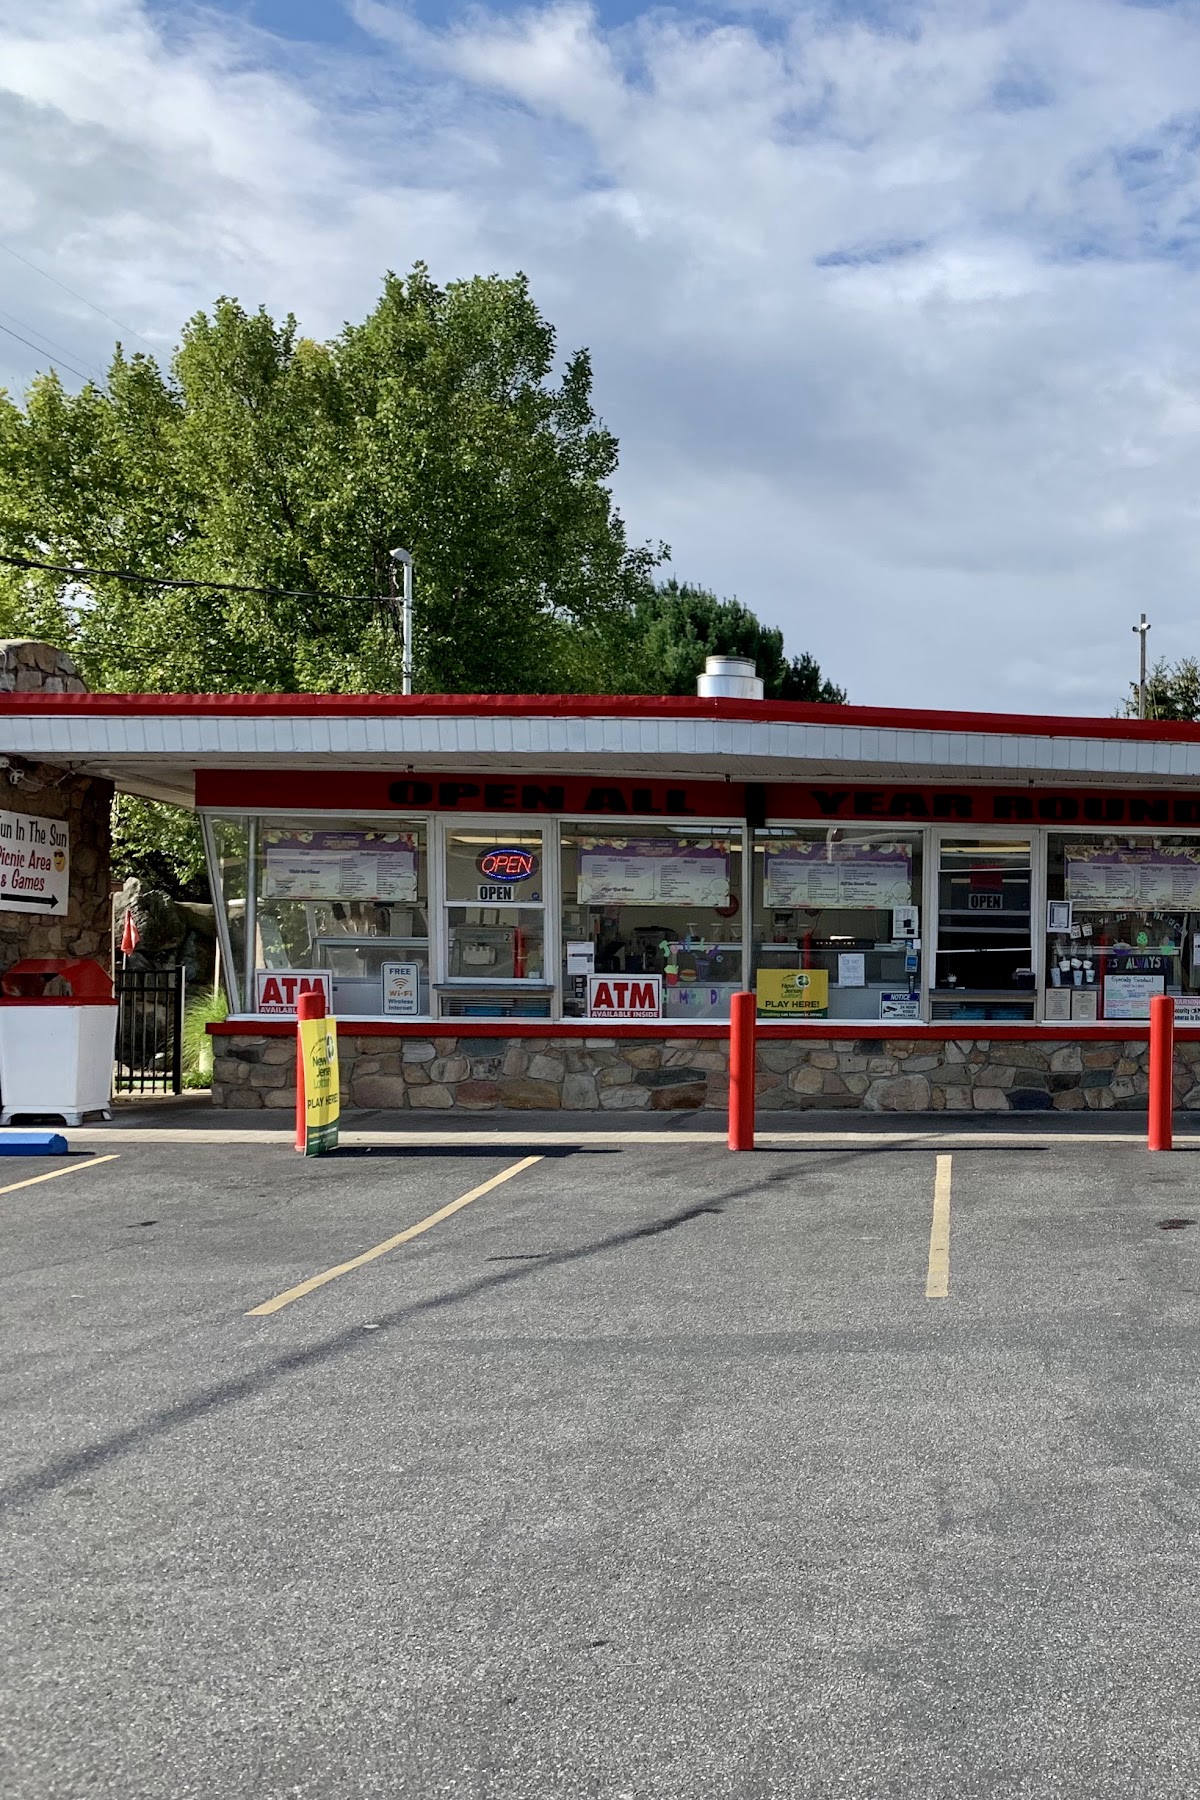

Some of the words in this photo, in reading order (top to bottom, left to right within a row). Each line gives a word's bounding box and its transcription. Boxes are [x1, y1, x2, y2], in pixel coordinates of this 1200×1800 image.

[387, 780, 565, 809] OPEN
[584, 786, 696, 814] ALL
[808, 790, 973, 818] YEAR
[0, 816, 12, 839] un
[16, 819, 25, 841] In
[29, 821, 46, 845] The
[50, 824, 67, 847] Sun
[28, 850, 52, 871] Area
[481, 856, 533, 874] OPEN
[0, 873, 7, 888] &
[11, 868, 45, 892] Games
[480, 886, 512, 900] OPEN
[971, 895, 1001, 908] OPEN
[389, 968, 412, 976] FREE
[261, 978, 325, 1005] ATM
[389, 989, 413, 997] Wi-Fi
[593, 983, 656, 1009] ATM
[313, 1056, 327, 1067] New
[307, 1096, 325, 1109] PLAY
